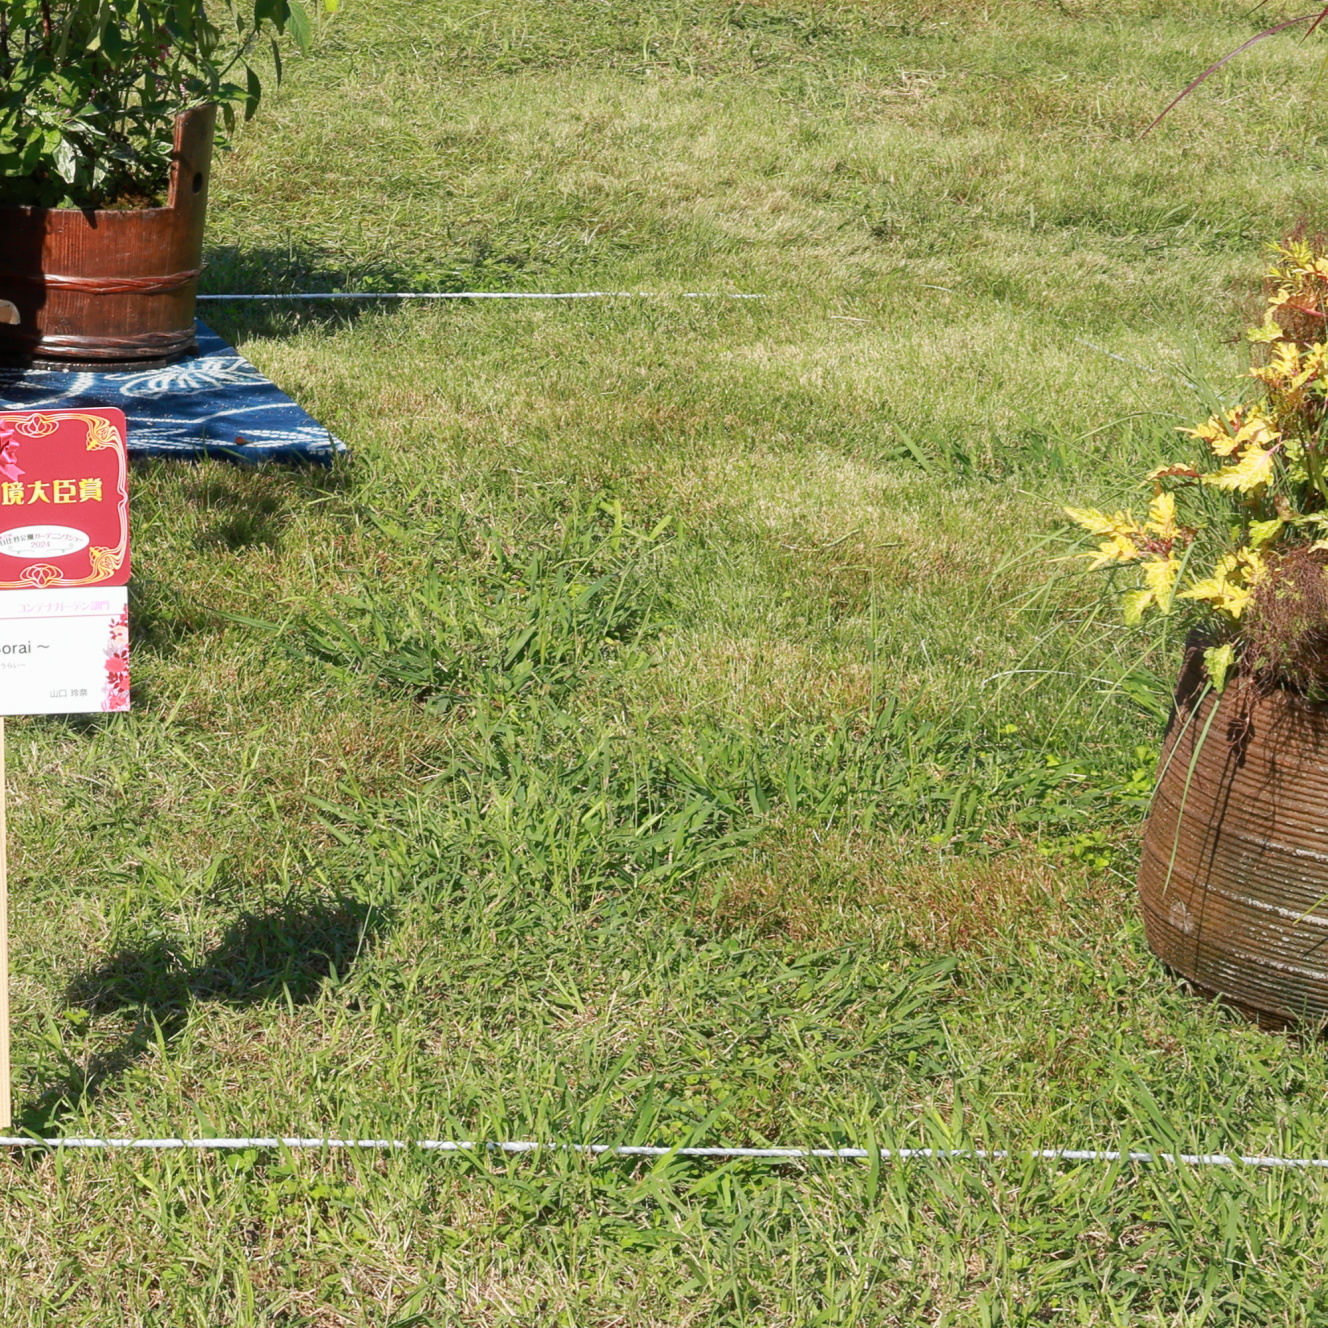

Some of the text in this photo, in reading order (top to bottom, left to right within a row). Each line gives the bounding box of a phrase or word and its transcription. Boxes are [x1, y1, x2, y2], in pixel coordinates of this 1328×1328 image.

[0, 533, 85, 547] 日比谷公園ガーデニングショー
[17, 600, 110, 613] コンテナガーデン部門
[49, 688, 88, 698] 山口 玲奈
